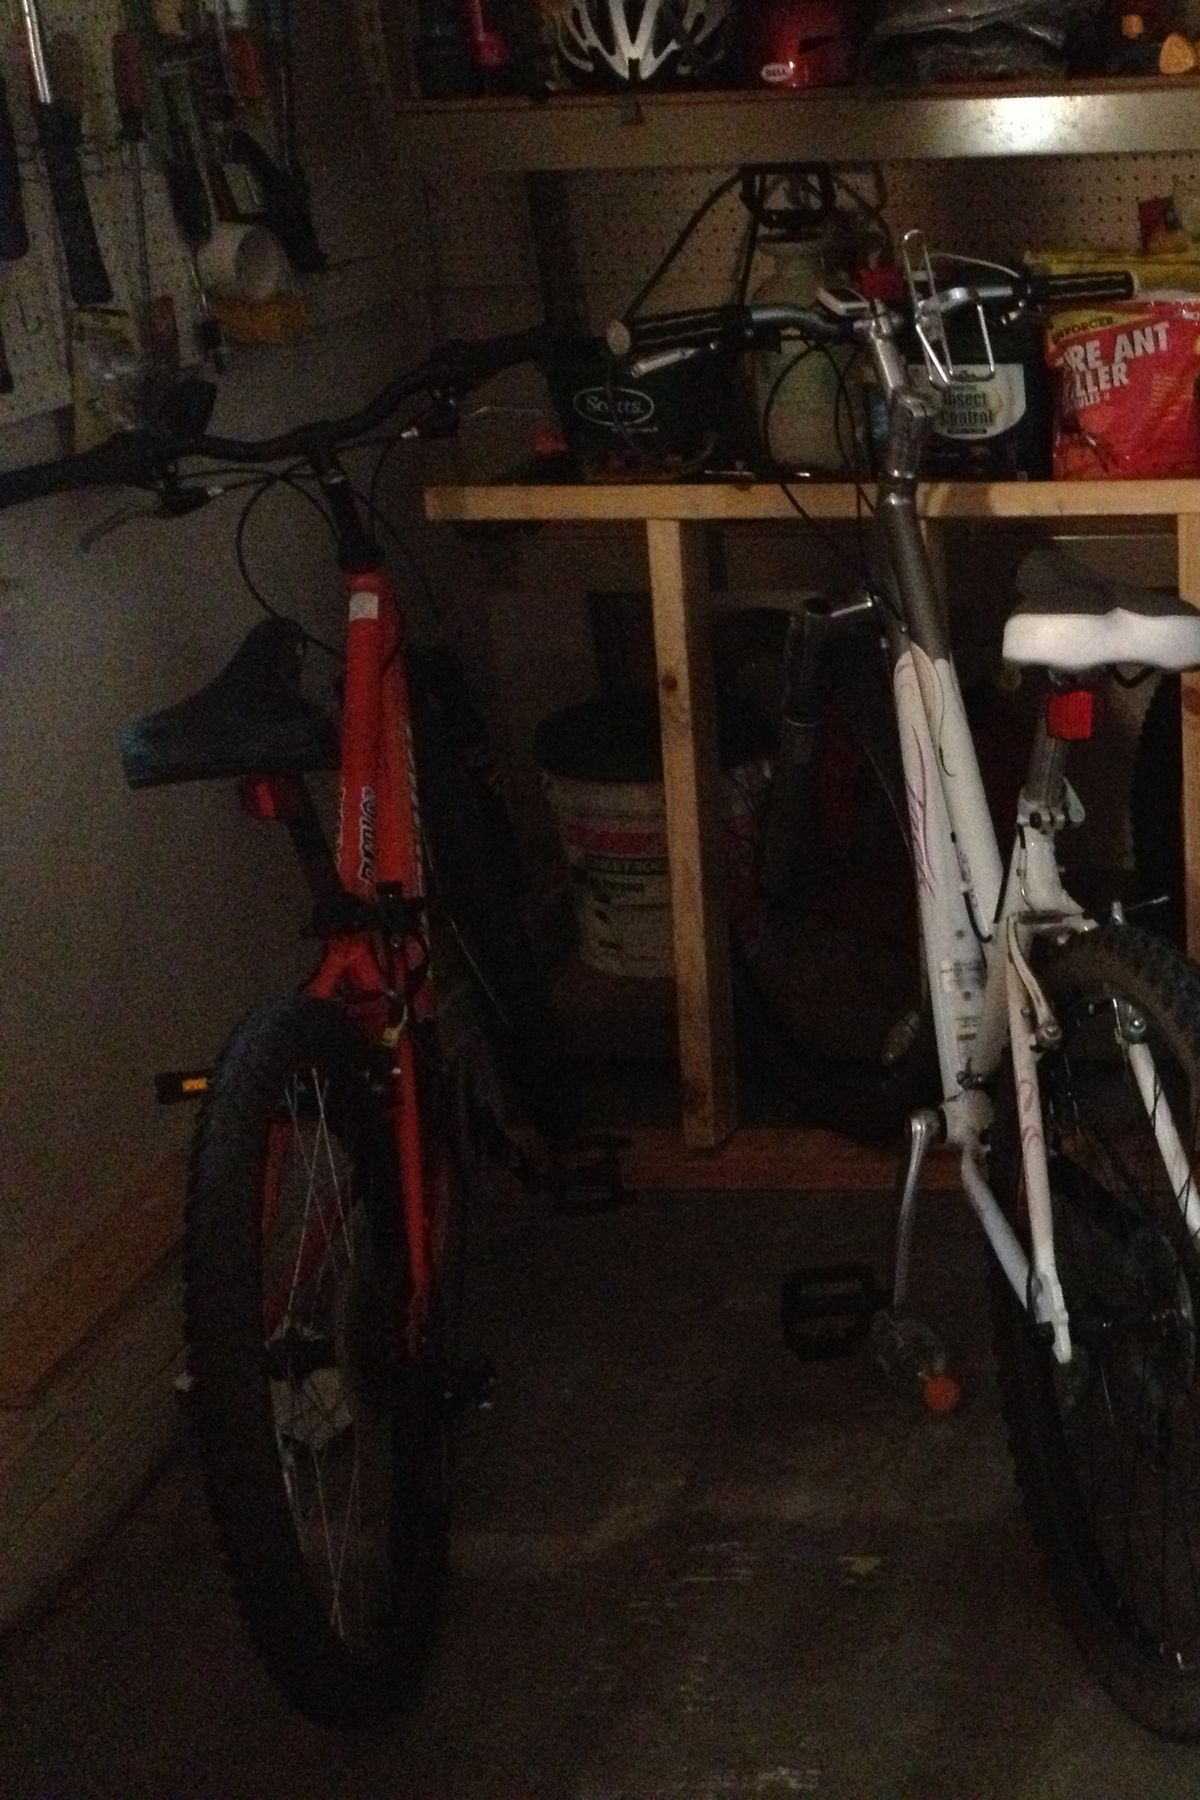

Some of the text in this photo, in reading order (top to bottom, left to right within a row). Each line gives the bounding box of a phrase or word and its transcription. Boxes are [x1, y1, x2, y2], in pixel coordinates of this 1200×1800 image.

[1114, 320, 1169, 364] ANT
[943, 392, 986, 409] Insect
[938, 408, 993, 427] Control
